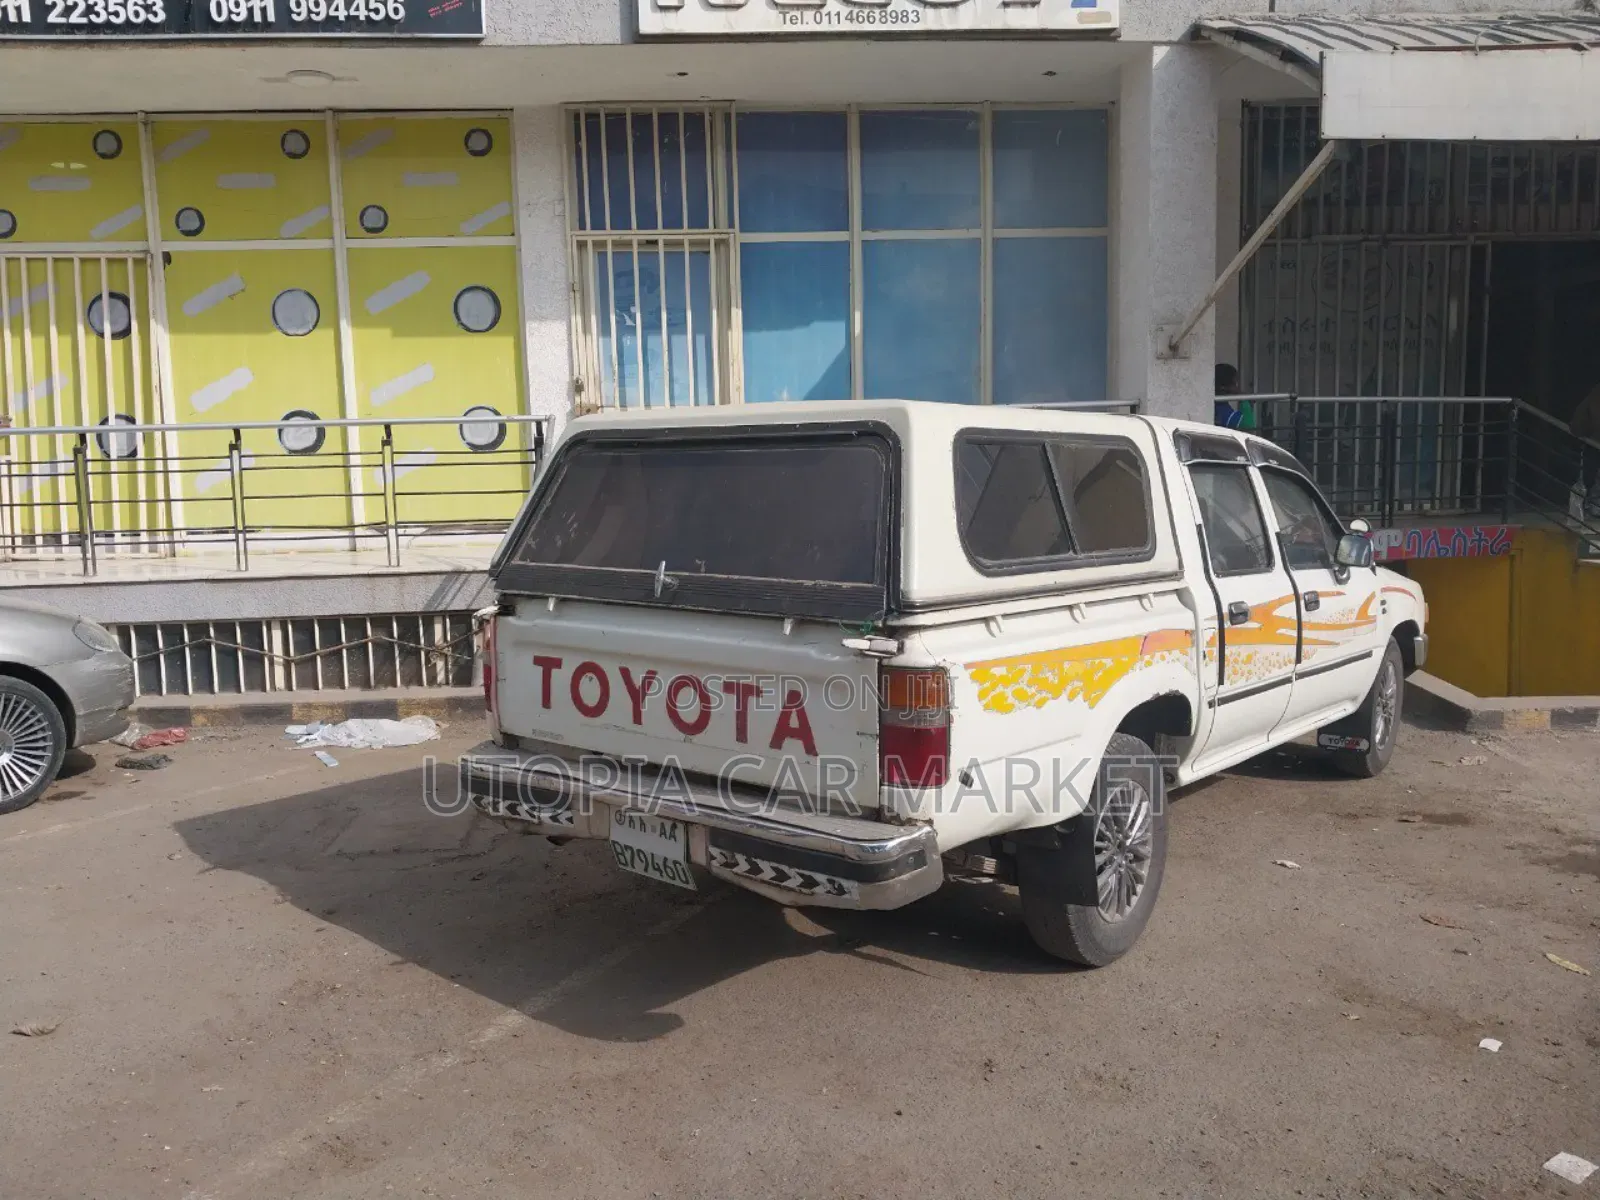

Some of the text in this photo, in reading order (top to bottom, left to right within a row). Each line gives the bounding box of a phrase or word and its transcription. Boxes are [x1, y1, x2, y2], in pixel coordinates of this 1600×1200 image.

[45, 0, 166, 24] 223563
[209, 0, 276, 23] 0911
[289, 0, 406, 23] 994456
[778, 11, 809, 25] Tel.
[533, 655, 818, 757] TOYOTA
[610, 840, 690, 885] B79460
